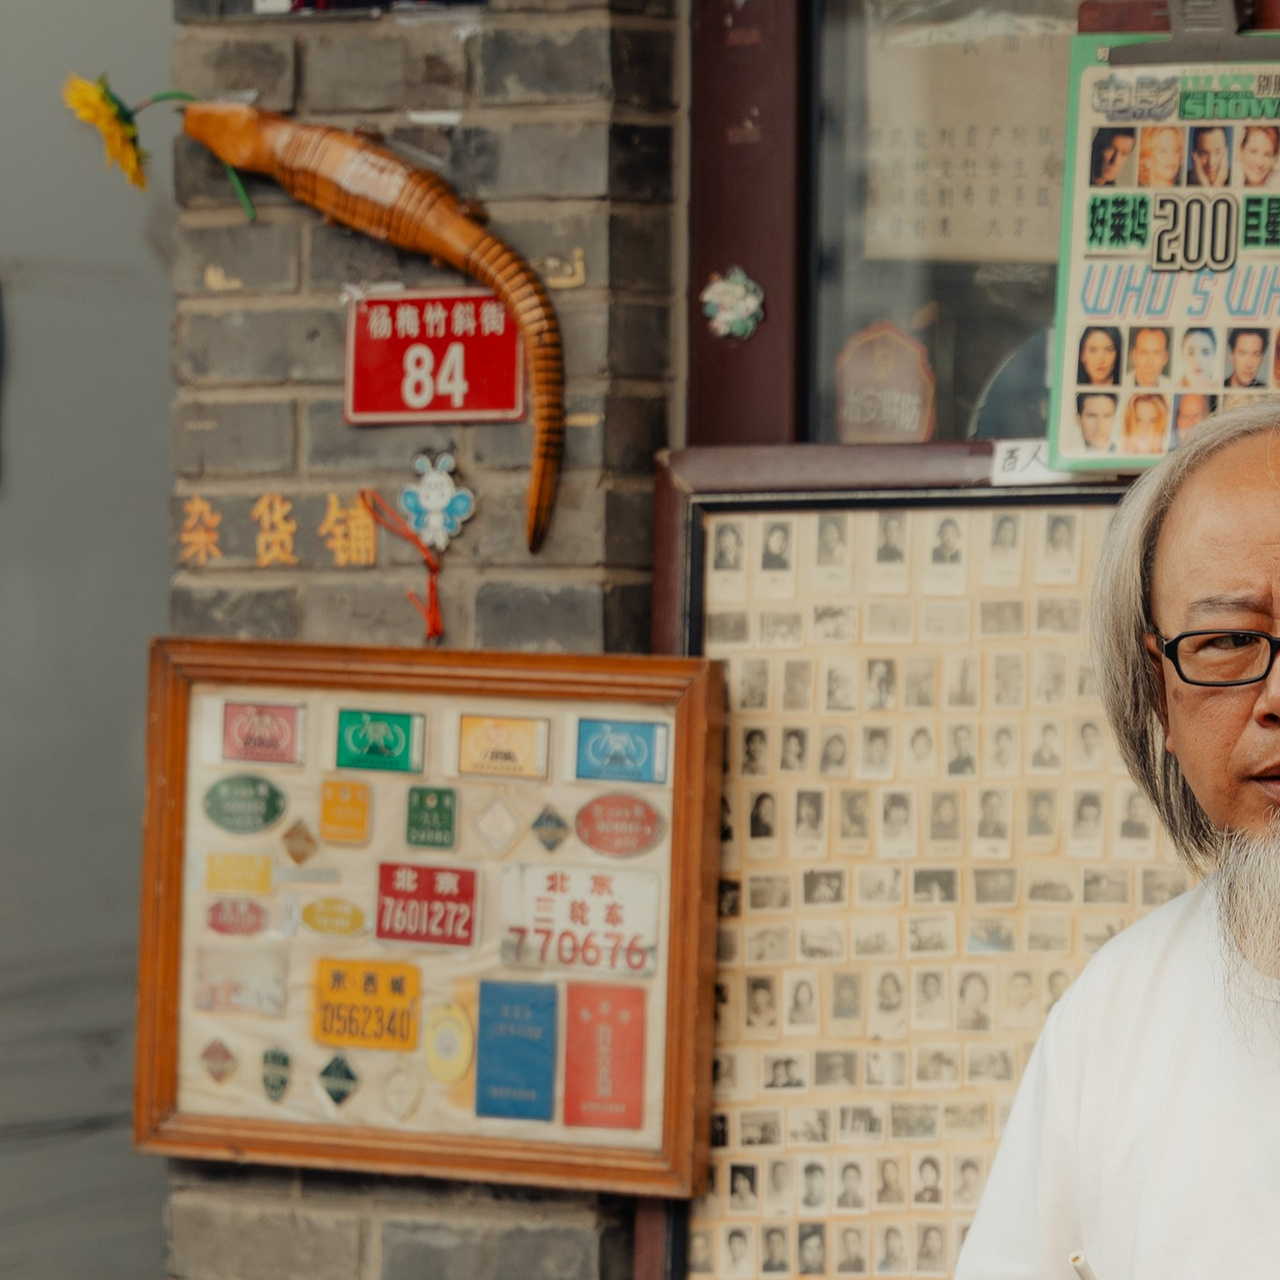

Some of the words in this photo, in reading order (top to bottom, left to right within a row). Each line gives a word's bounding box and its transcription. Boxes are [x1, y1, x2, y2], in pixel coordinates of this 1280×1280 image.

[1088, 194, 1151, 247] 好莱坞
[1152, 192, 1239, 273] 200
[368, 302, 507, 339] 杨梅竹斜街
[401, 342, 468, 408] 84
[179, 492, 378, 567] 杂货铺
[392, 868, 460, 894] 北京
[546, 872, 615, 896] 北京
[381, 898, 471, 939] 7601272
[534, 896, 625, 927] 三轮车
[508, 926, 647, 971] 770676
[321, 1003, 412, 1041] 0562340
